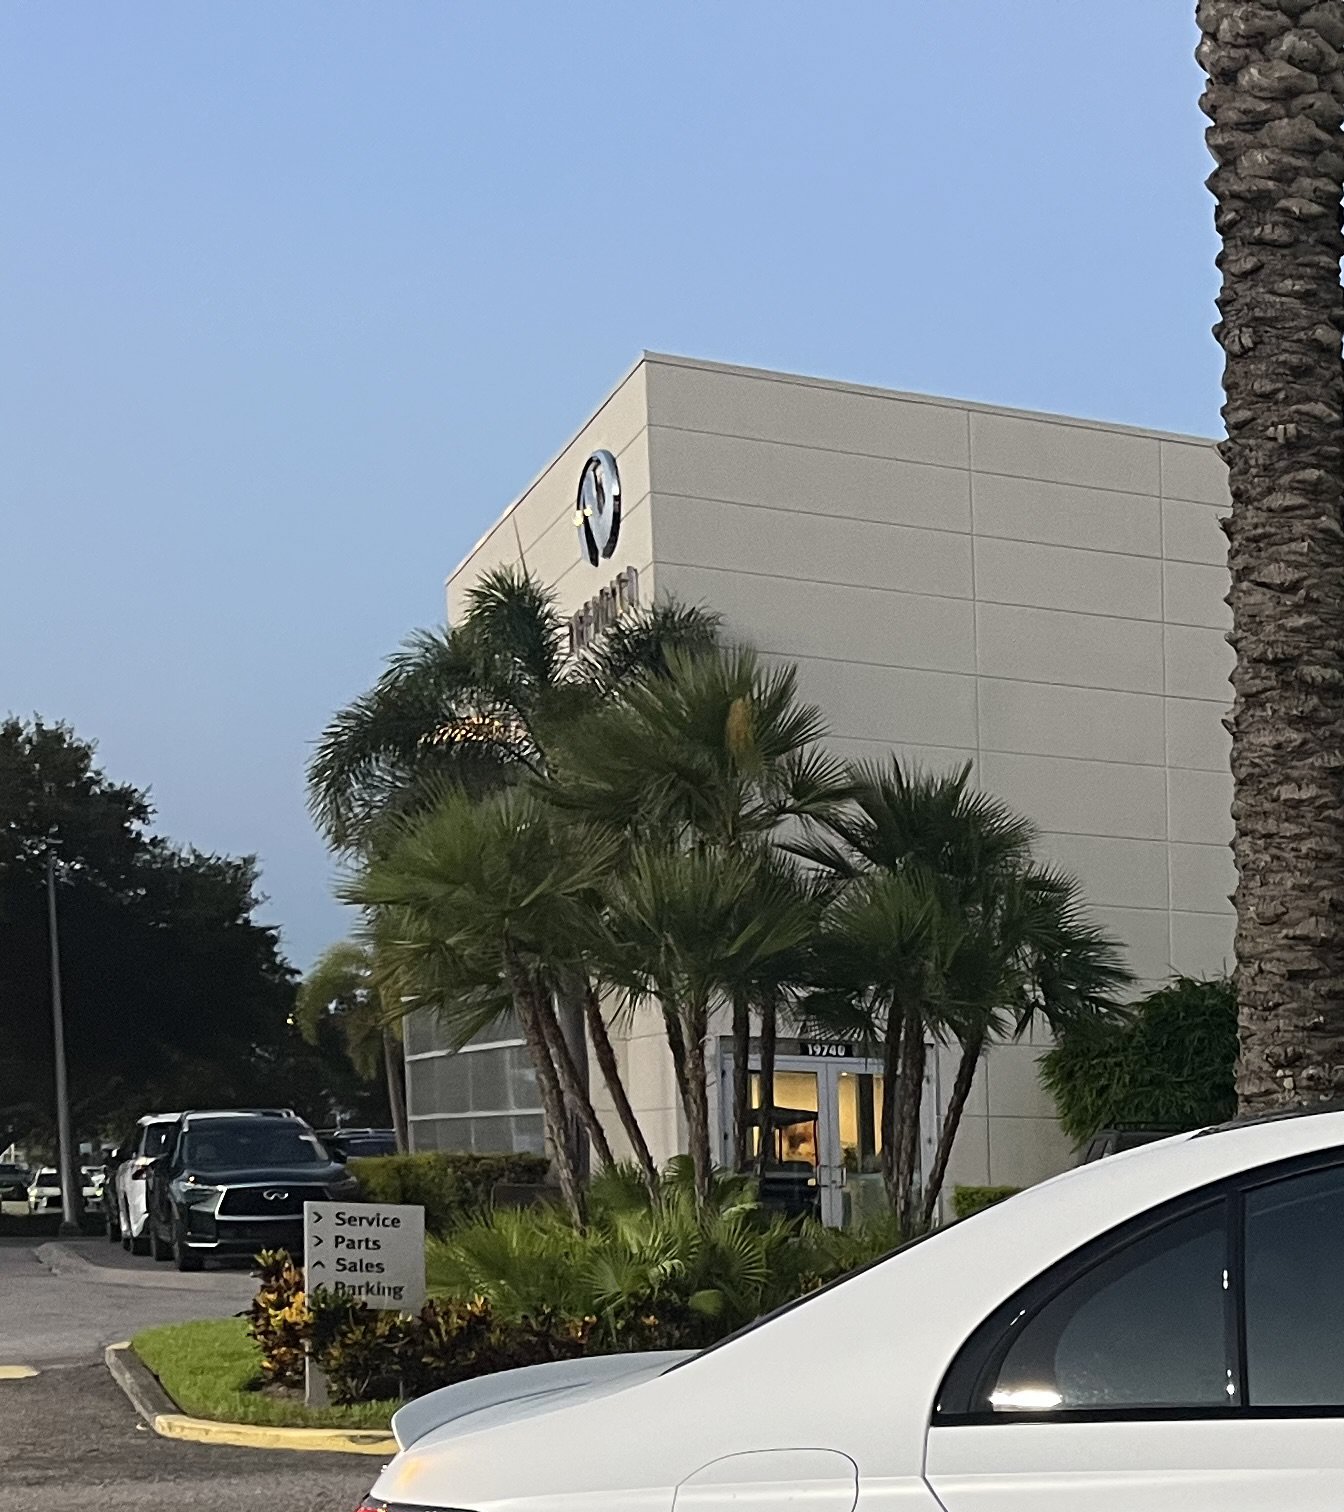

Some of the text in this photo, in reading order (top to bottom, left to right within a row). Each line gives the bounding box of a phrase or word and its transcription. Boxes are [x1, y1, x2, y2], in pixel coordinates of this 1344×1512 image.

[807, 1043, 846, 1057] 19740
[335, 1211, 401, 1228] Service
[334, 1234, 382, 1250] Parts
[335, 1257, 385, 1273] Sales
